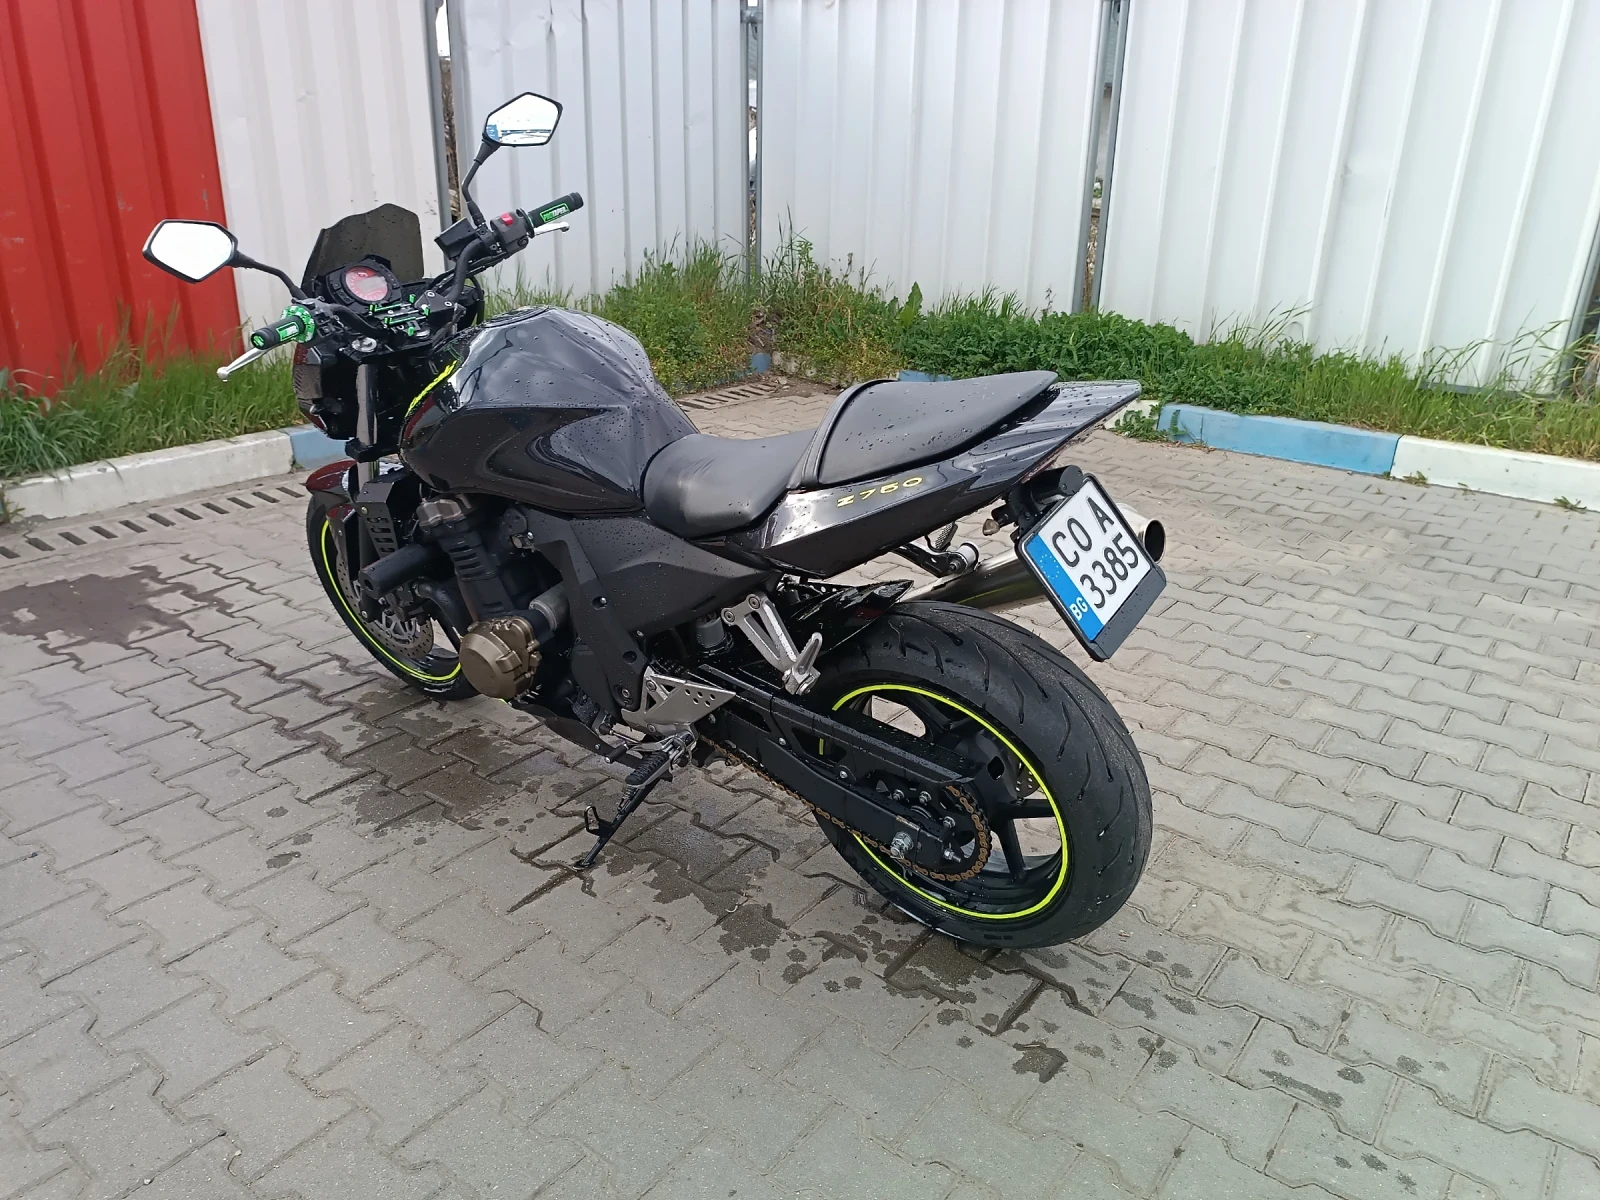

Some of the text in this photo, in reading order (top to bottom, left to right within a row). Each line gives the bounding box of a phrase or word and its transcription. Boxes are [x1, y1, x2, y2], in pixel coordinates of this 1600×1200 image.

[1051, 496, 1115, 568] CO A
[1079, 532, 1139, 609] 3385
[1069, 596, 1089, 621] BG
